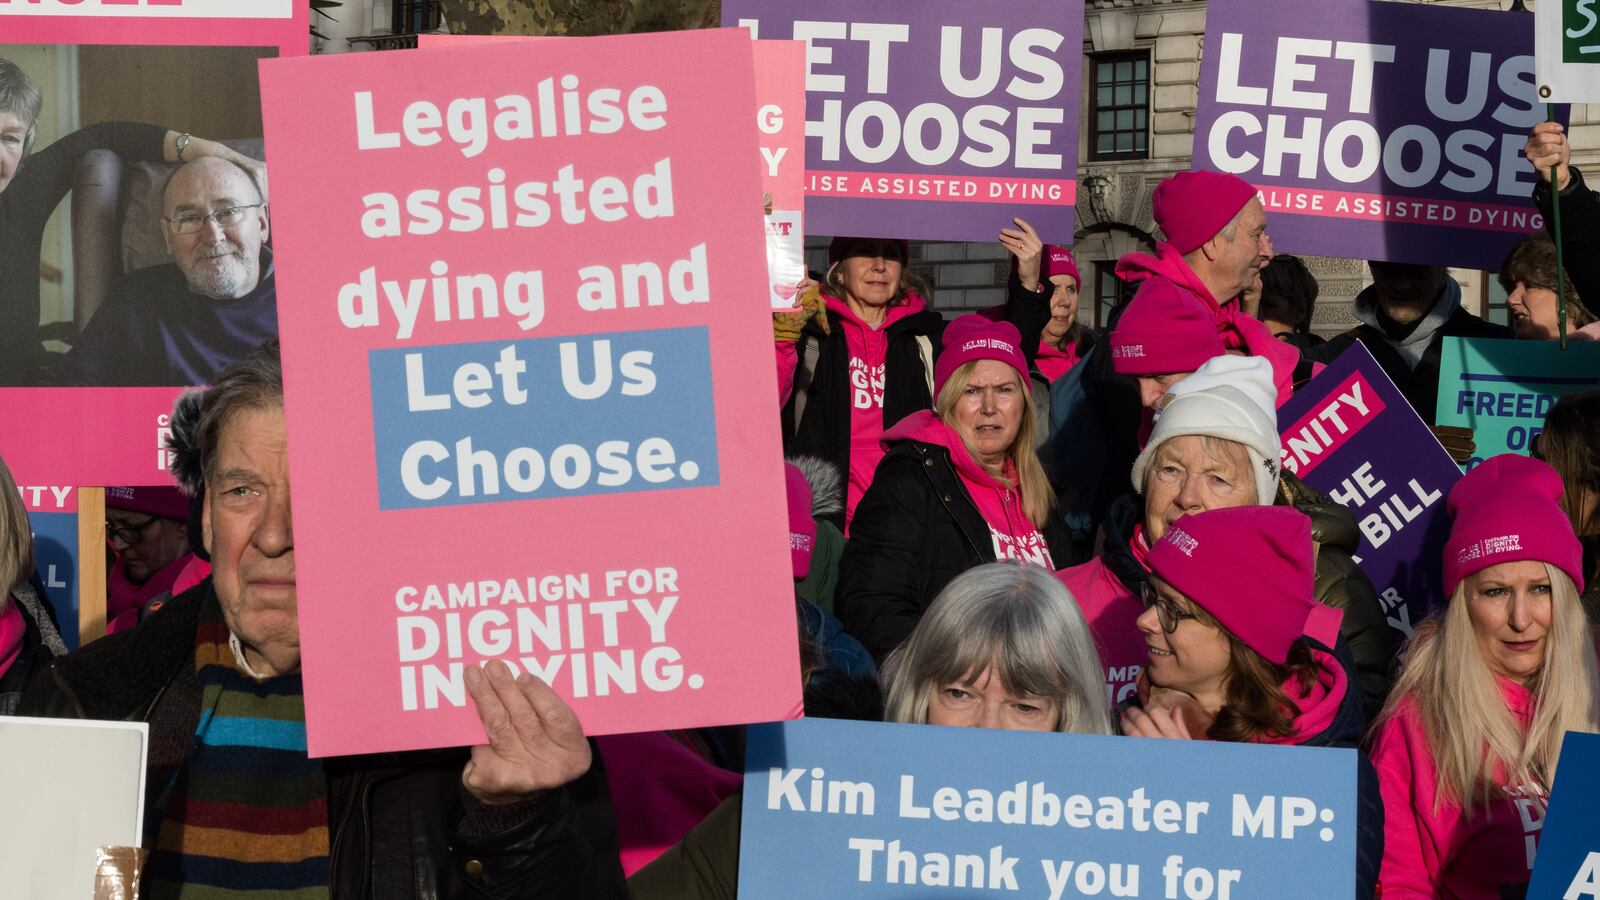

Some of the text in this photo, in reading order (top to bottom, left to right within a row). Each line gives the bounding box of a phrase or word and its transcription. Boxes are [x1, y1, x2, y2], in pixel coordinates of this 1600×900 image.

[739, 19, 1064, 100] ET US
[1215, 32, 1547, 128] LET US
[354, 74, 668, 158] Legalise
[803, 175, 1061, 200] ISE ASSISTED DYING
[1208, 111, 1537, 198] CHOOSE
[361, 157, 674, 238] assisted
[1335, 196, 1456, 222] ASSISTED
[1468, 208, 1543, 230] DYING
[338, 260, 545, 339] dying
[577, 243, 710, 311] and
[405, 340, 657, 411] Let Us
[401, 436, 700, 500] Choose.
[1358, 478, 1442, 550] BILL
[395, 567, 680, 613] CAMPAIGN FOR
[396, 595, 680, 663] DIGNITY
[399, 662, 467, 712] IN
[767, 768, 1335, 842] Kim Leadbeater MP:
[848, 838, 1242, 900] Thank you for
